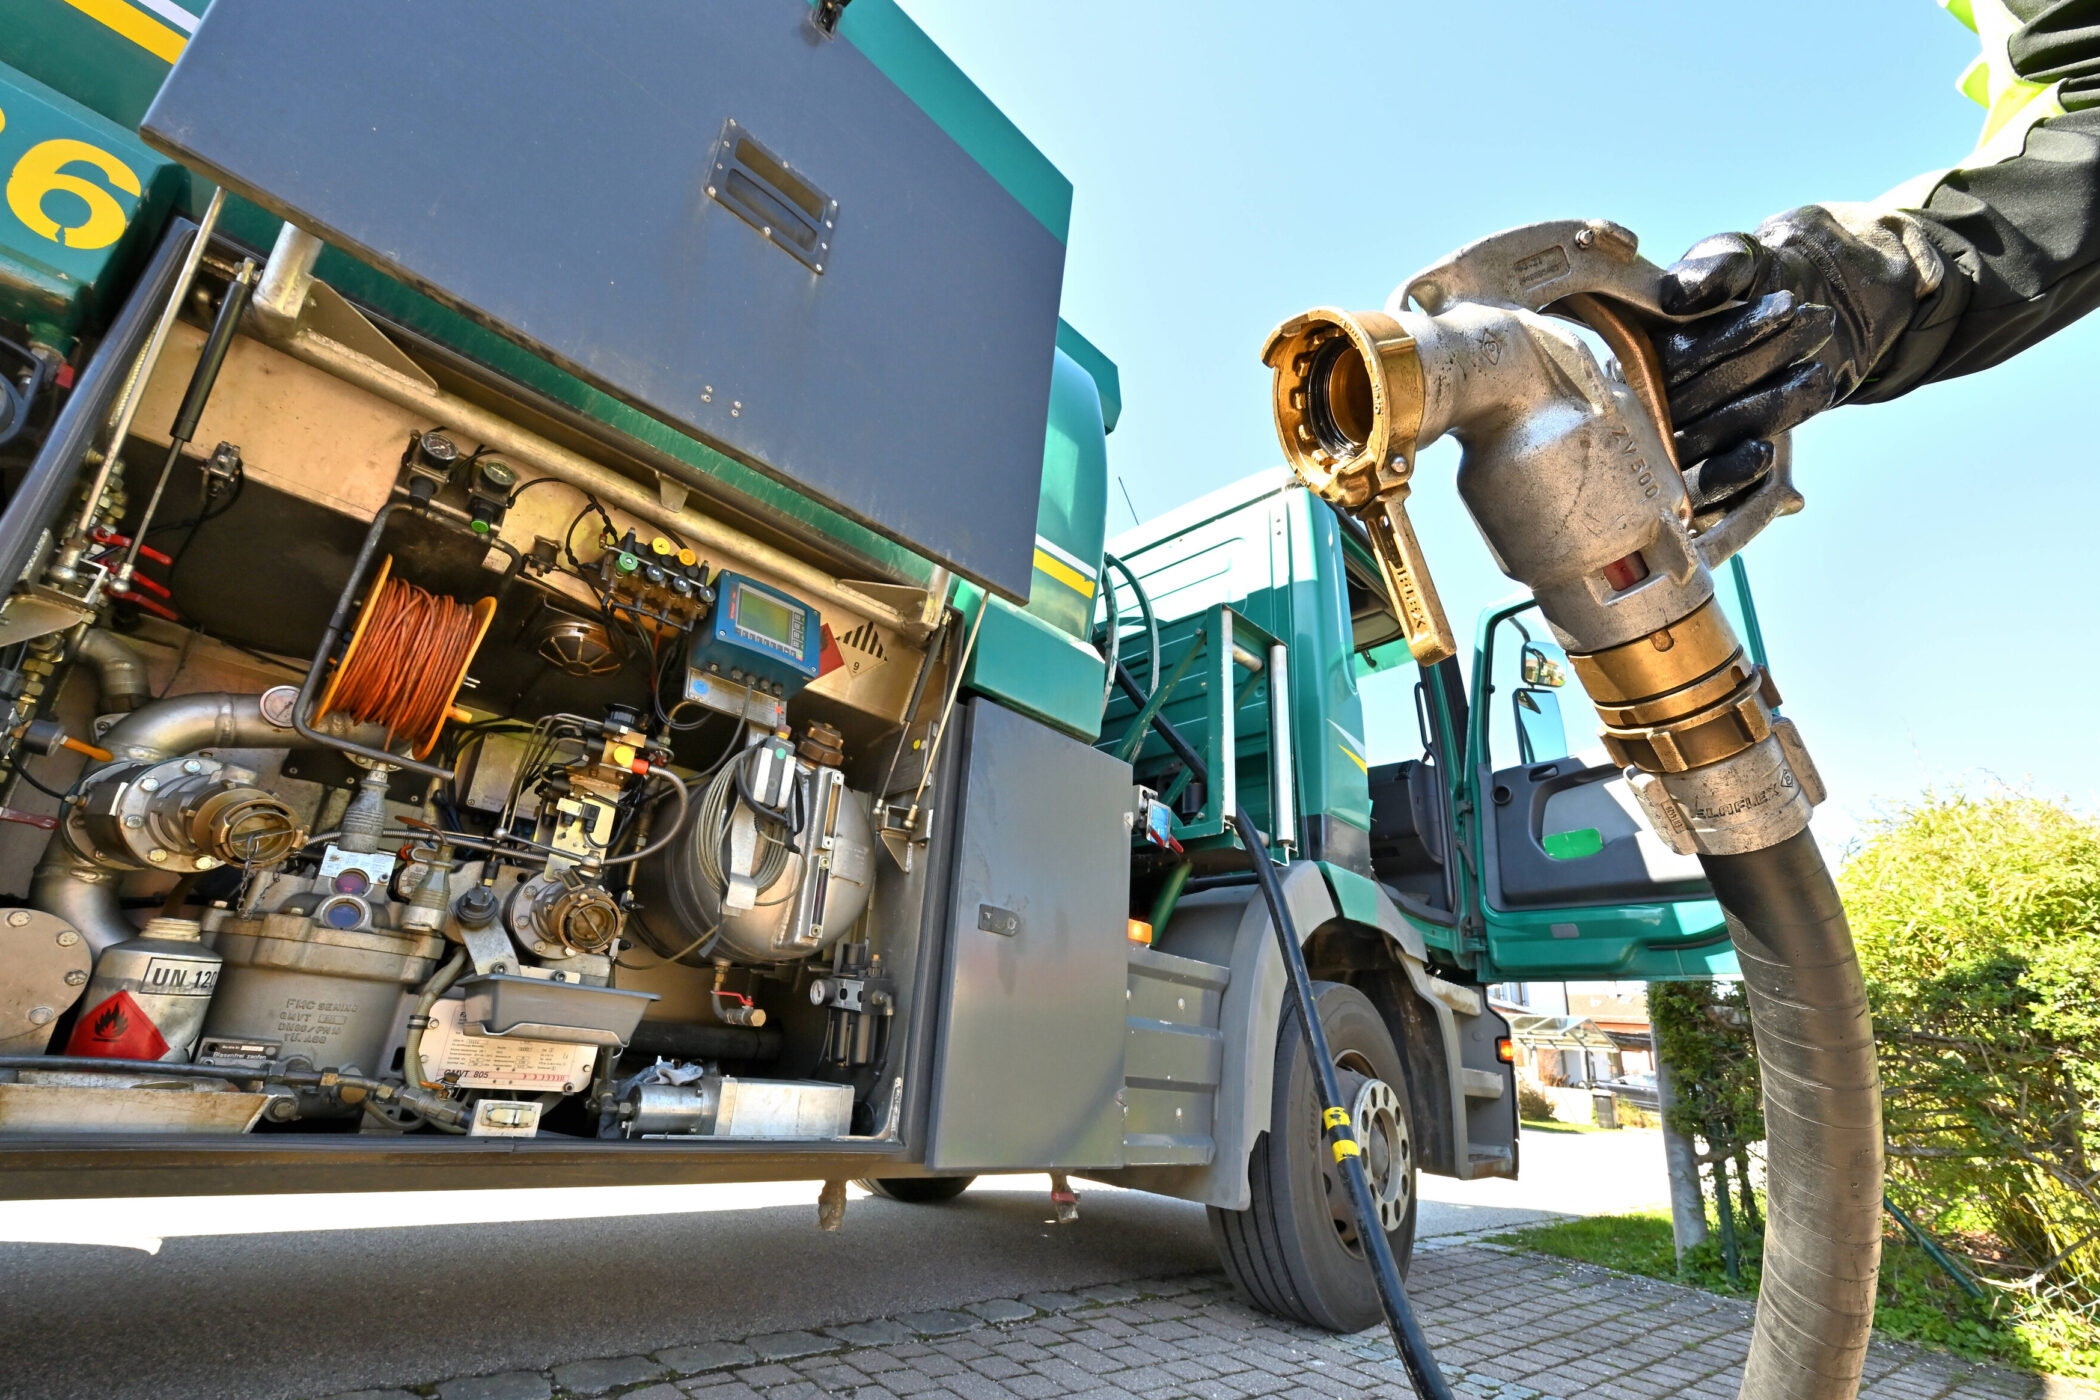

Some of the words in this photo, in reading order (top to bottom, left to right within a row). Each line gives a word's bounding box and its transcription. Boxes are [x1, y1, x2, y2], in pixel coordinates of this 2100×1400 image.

[0, 107, 142, 250] 6
[152, 967, 188, 988] UN
[473, 1070, 489, 1078] 805
